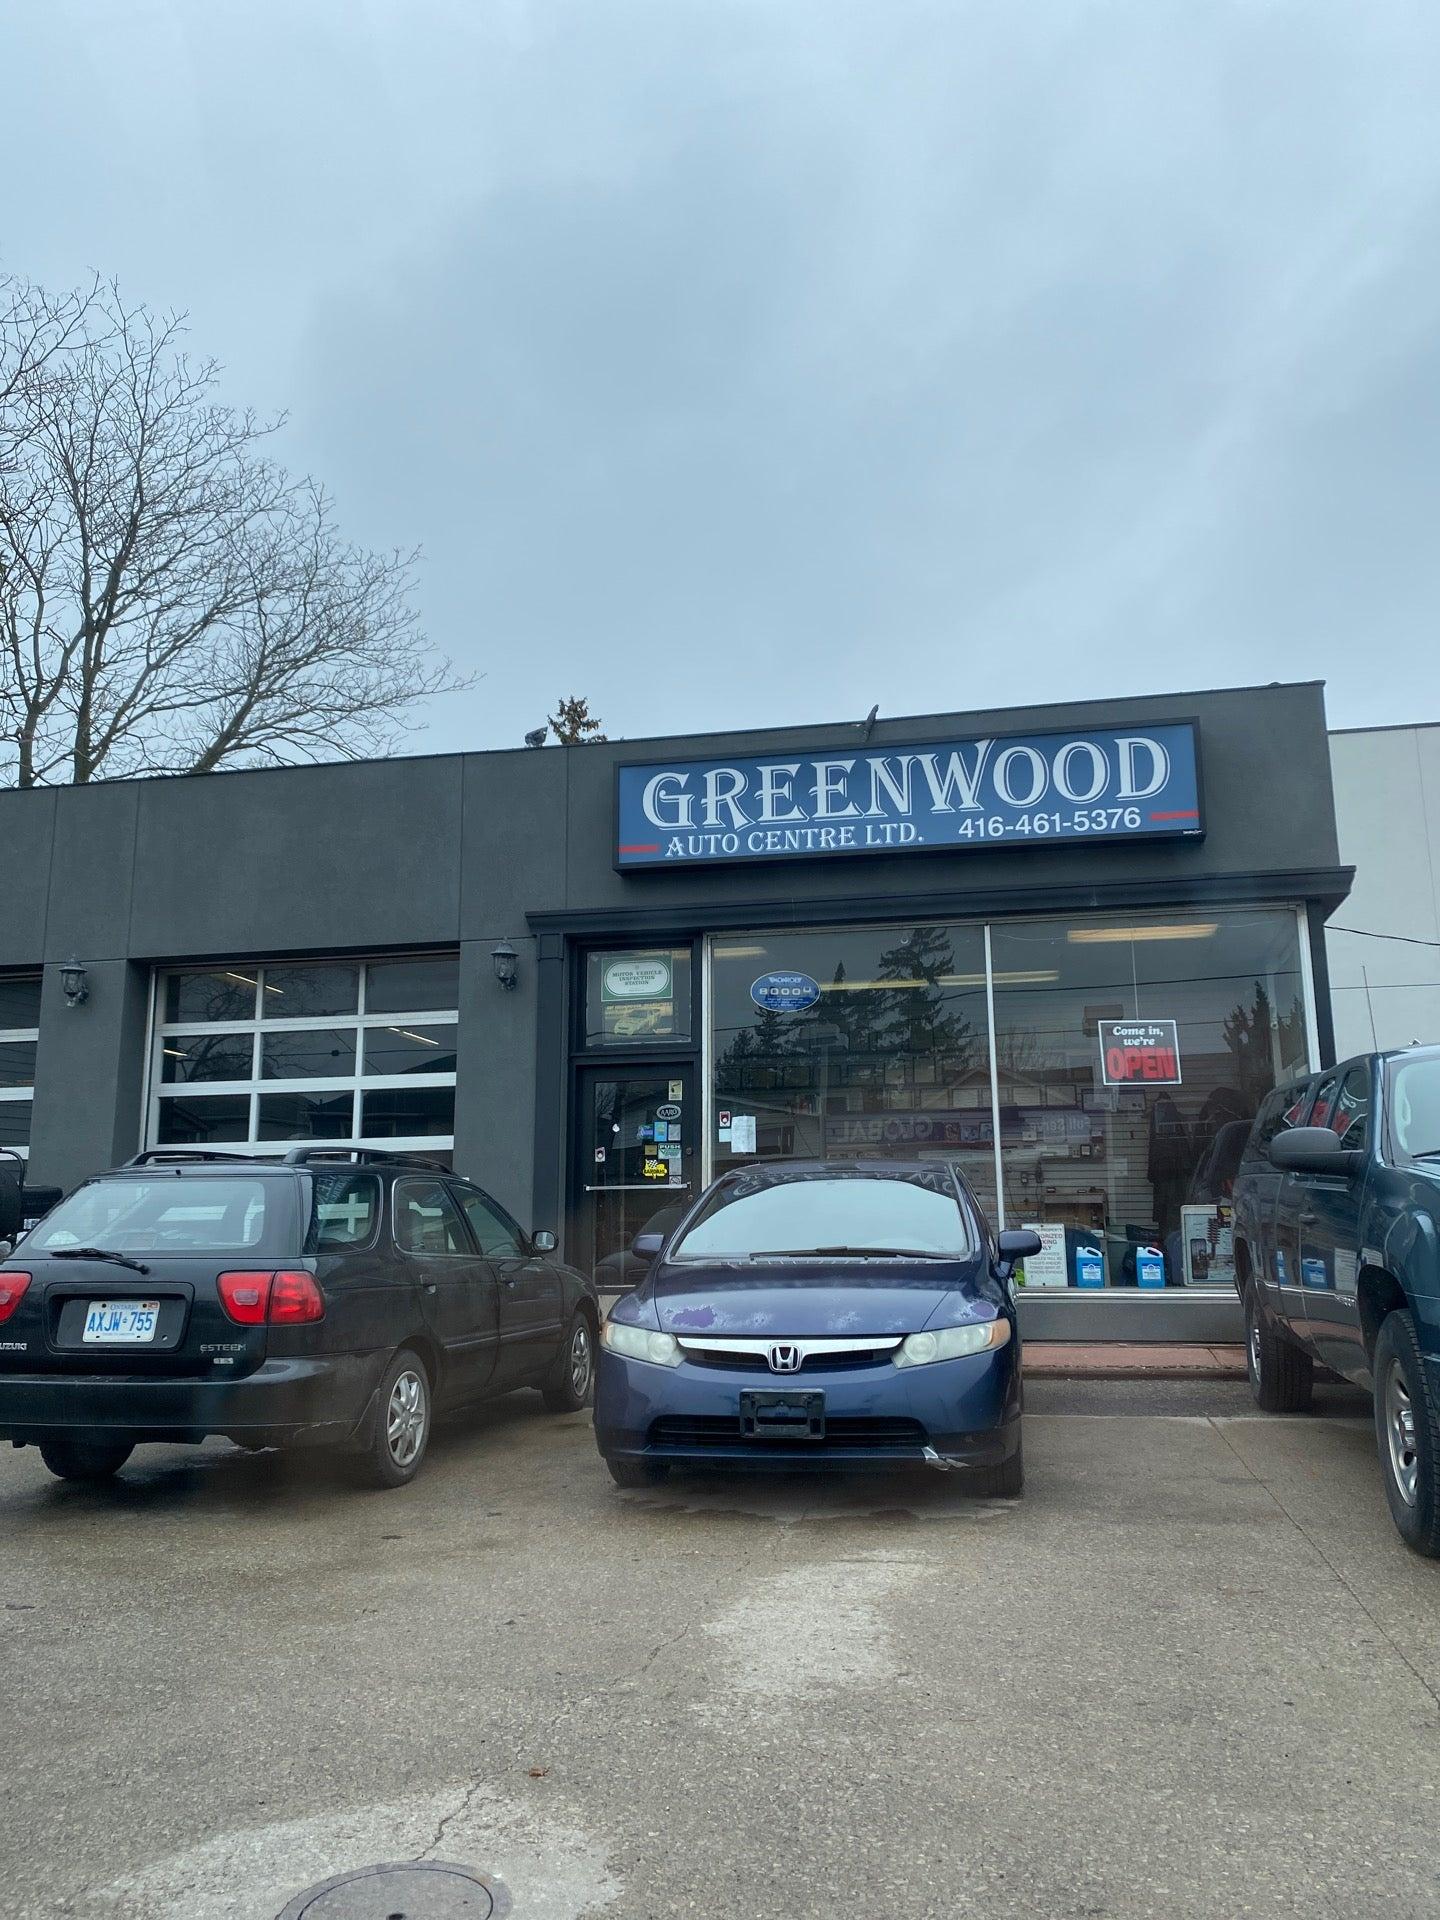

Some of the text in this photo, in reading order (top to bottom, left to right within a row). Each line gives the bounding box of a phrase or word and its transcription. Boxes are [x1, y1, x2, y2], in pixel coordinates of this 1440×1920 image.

[642, 737, 1171, 831] GREENWOOD
[958, 806, 1142, 839] 416-461-5376
[664, 822, 925, 858] AUTO CENTRE LTD.
[1112, 1025, 1164, 1037] Come in,
[1123, 1036, 1156, 1046] we're
[1106, 1047, 1176, 1080] OPEN
[0, 1342, 27, 1351] UZUKI
[200, 1344, 247, 1352] ESTEEM
